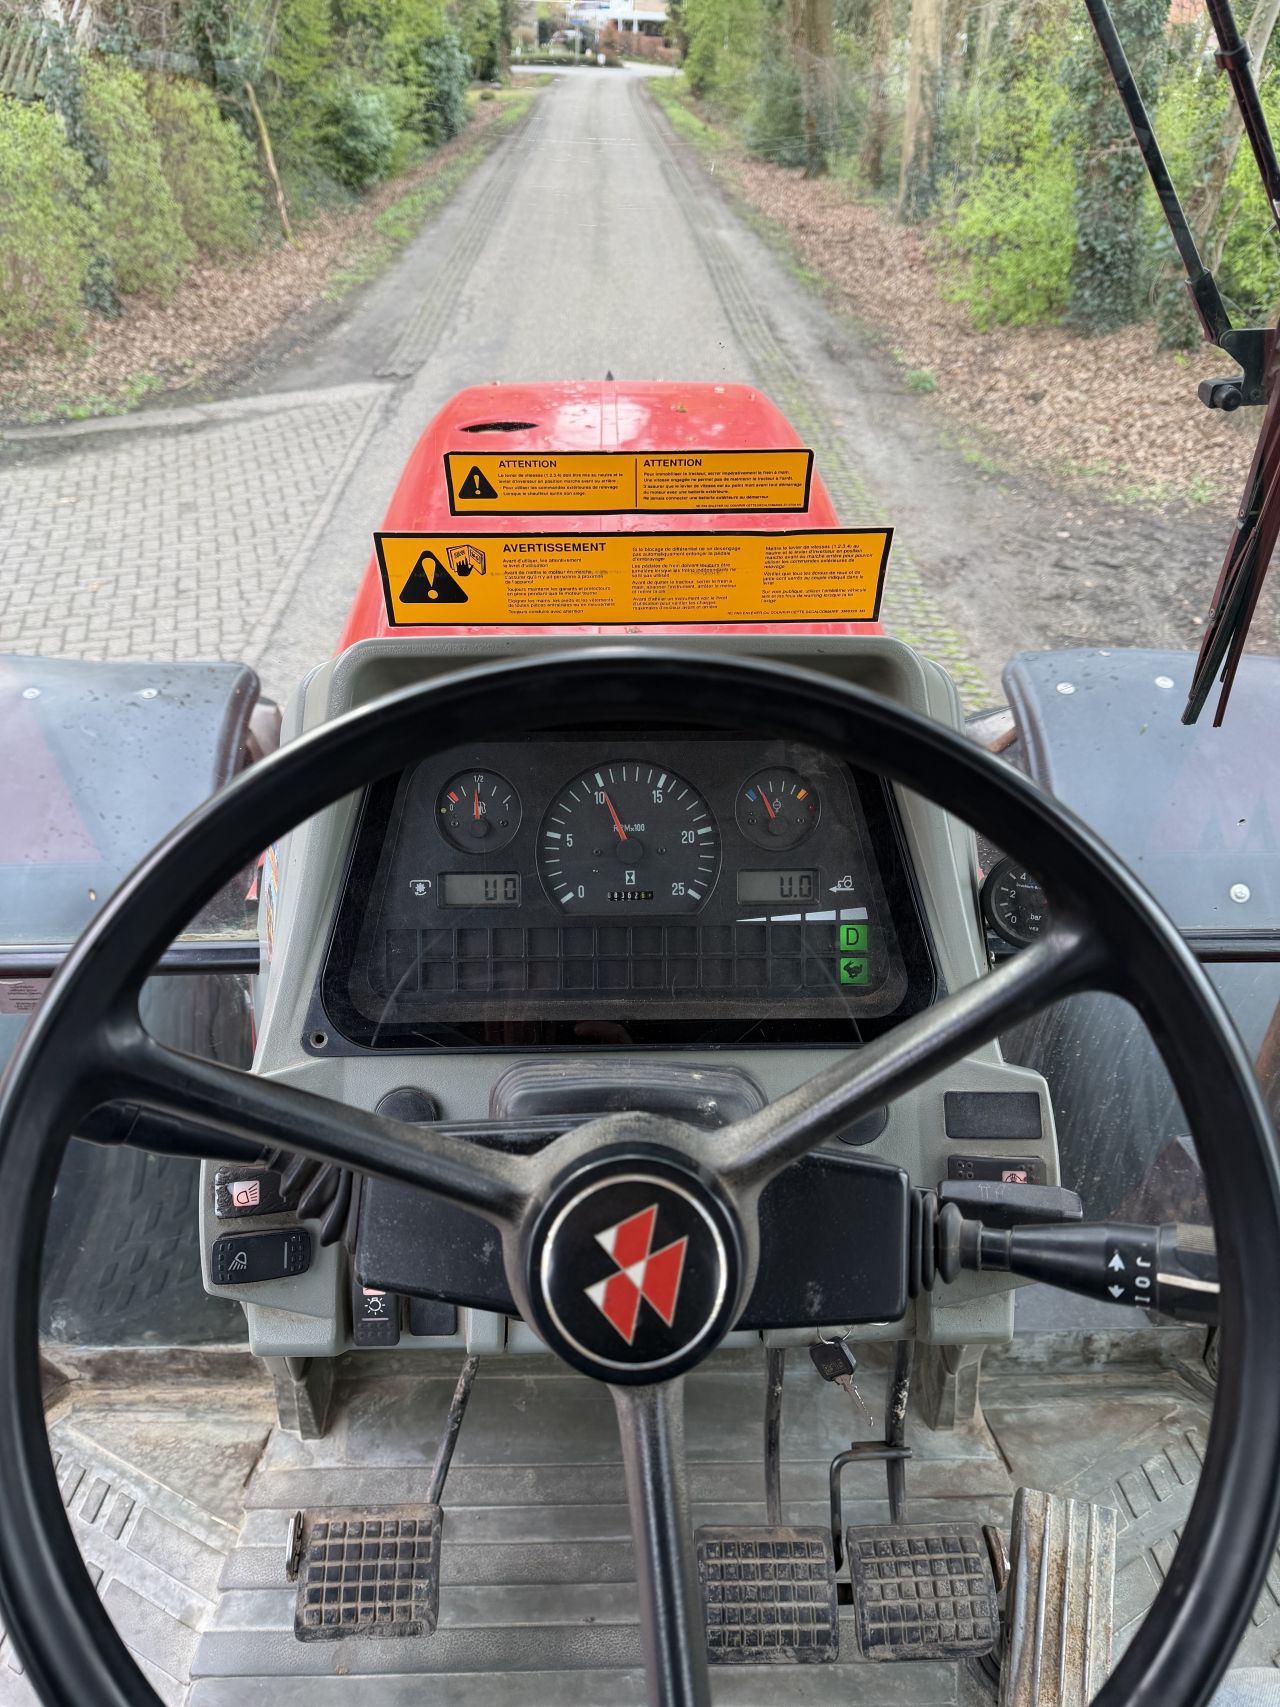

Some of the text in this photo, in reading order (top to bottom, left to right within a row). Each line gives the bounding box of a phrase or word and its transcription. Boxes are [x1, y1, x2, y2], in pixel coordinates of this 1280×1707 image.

[499, 460, 557, 468] ATTENTION
[643, 459, 702, 467] ATTENTION
[503, 542, 606, 552] AVERTISSEMENT
[473, 775, 484, 783] 1/2
[594, 791, 605, 805] 10
[652, 790, 663, 803] 15
[566, 834, 573, 847] 5
[681, 831, 695, 844] 20
[1020, 872, 1027, 880] 4
[578, 885, 585, 898] 0
[671, 883, 685, 896] 25
[1010, 890, 1016, 898] 2
[1010, 915, 1017, 924] 0
[1030, 913, 1042, 921] bar
[845, 927, 860, 946] D
